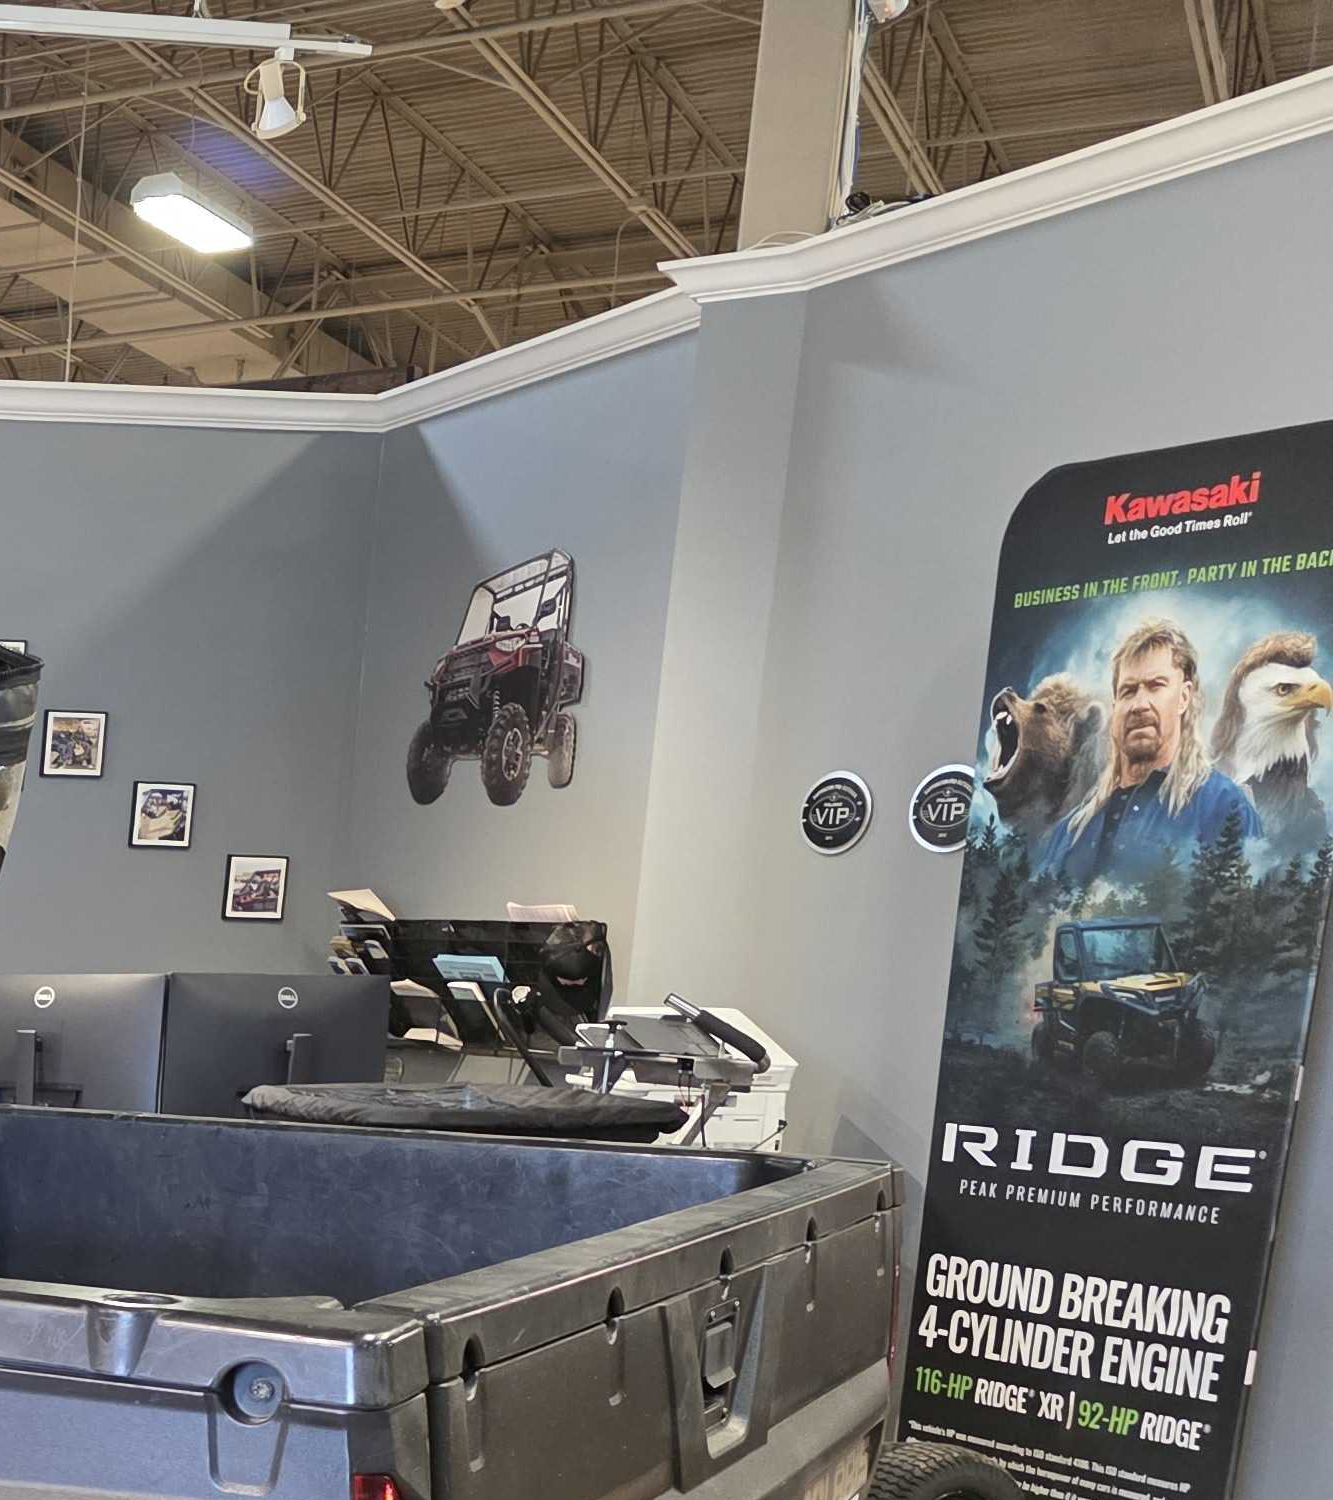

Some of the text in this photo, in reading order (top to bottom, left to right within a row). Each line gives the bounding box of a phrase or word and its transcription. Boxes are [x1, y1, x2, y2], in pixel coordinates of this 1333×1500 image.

[1104, 471, 1262, 525] Kawasaki
[1108, 531, 1127, 544] Let
[1129, 528, 1148, 541] the
[1150, 522, 1182, 538] Good
[1184, 516, 1221, 534] Times
[1014, 583, 1080, 609] BUSINESS
[1083, 580, 1098, 598] IN
[1101, 576, 1129, 596] THE
[1131, 569, 1182, 592] FRONT.
[1187, 562, 1237, 585] PARTY
[1240, 560, 1257, 578] IN
[1262, 554, 1292, 575] THE
[815, 806, 850, 826] VIP
[927, 802, 966, 822] VIP
[941, 1122, 1257, 1193] RIDGE
[959, 1178, 1222, 1225] PEAK PREMIUM PERFORMANCE
[925, 1253, 1231, 1344] GROUND BREAKING
[918, 1304, 1225, 1402] 4-CYLINDER ENGINE
[915, 1366, 973, 1400] 116-HP
[1037, 1391, 1065, 1422] XR
[1077, 1399, 1139, 1436] 92-HP
